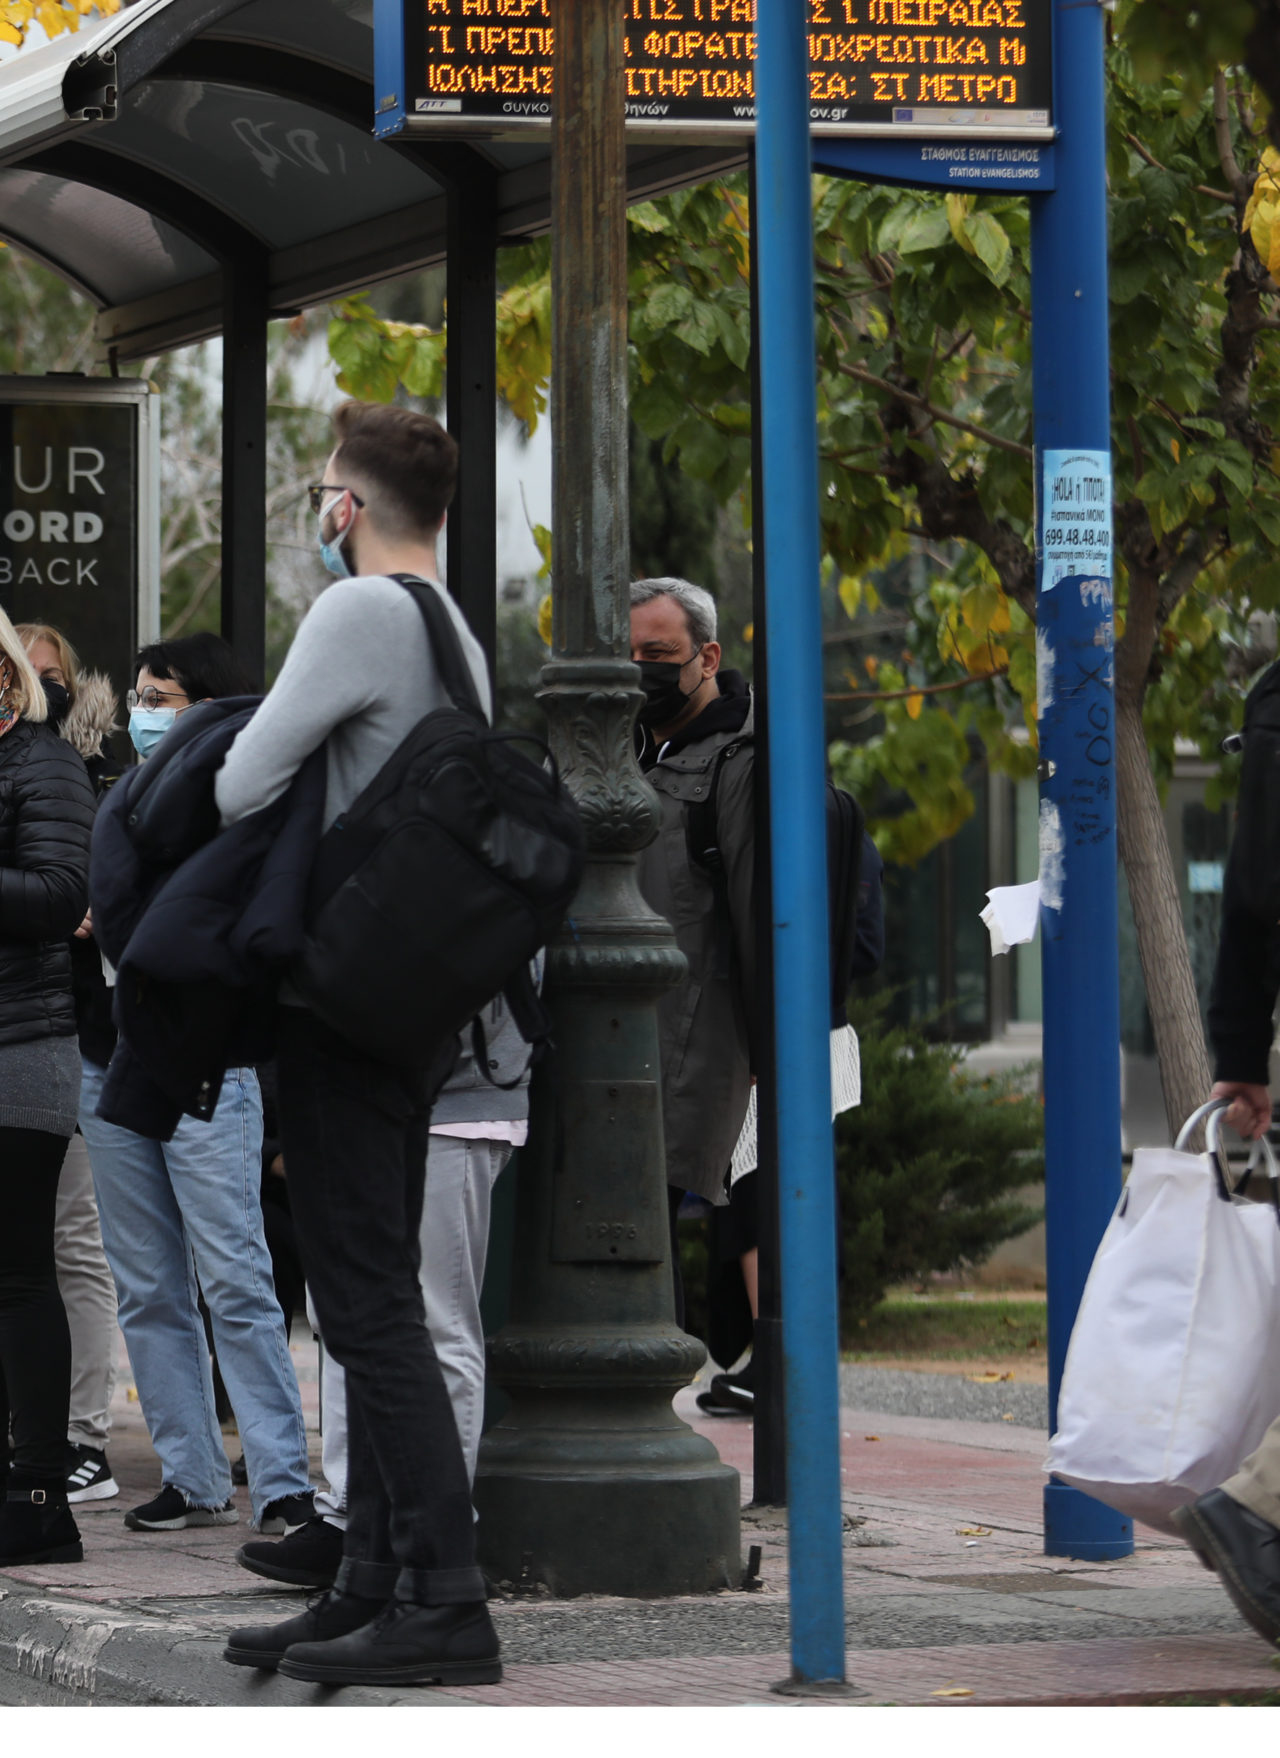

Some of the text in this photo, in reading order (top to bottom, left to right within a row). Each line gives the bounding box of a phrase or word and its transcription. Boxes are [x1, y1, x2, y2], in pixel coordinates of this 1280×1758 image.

[869, 0, 1026, 28] ΠΕΙΡΑΙΑΣ
[466, 26, 554, 55] ΠΡΕΠΕ
[644, 30, 758, 60] ΦΟΡΑΤΕ
[624, 67, 757, 98] ΙΤΗΡΙΩΝ
[870, 72, 910, 101] ΣΤ
[917, 73, 1017, 103] ΜΕΤΡΟ
[502, 101, 550, 116] συγκο
[920, 147, 1040, 162] ΣΤΑΘΜΟΣ ΕΥΑΓΓΕΛΙΣΜΟΣ
[948, 167, 981, 178] STATION
[1045, 528, 1110, 547] 699.48.48.400
